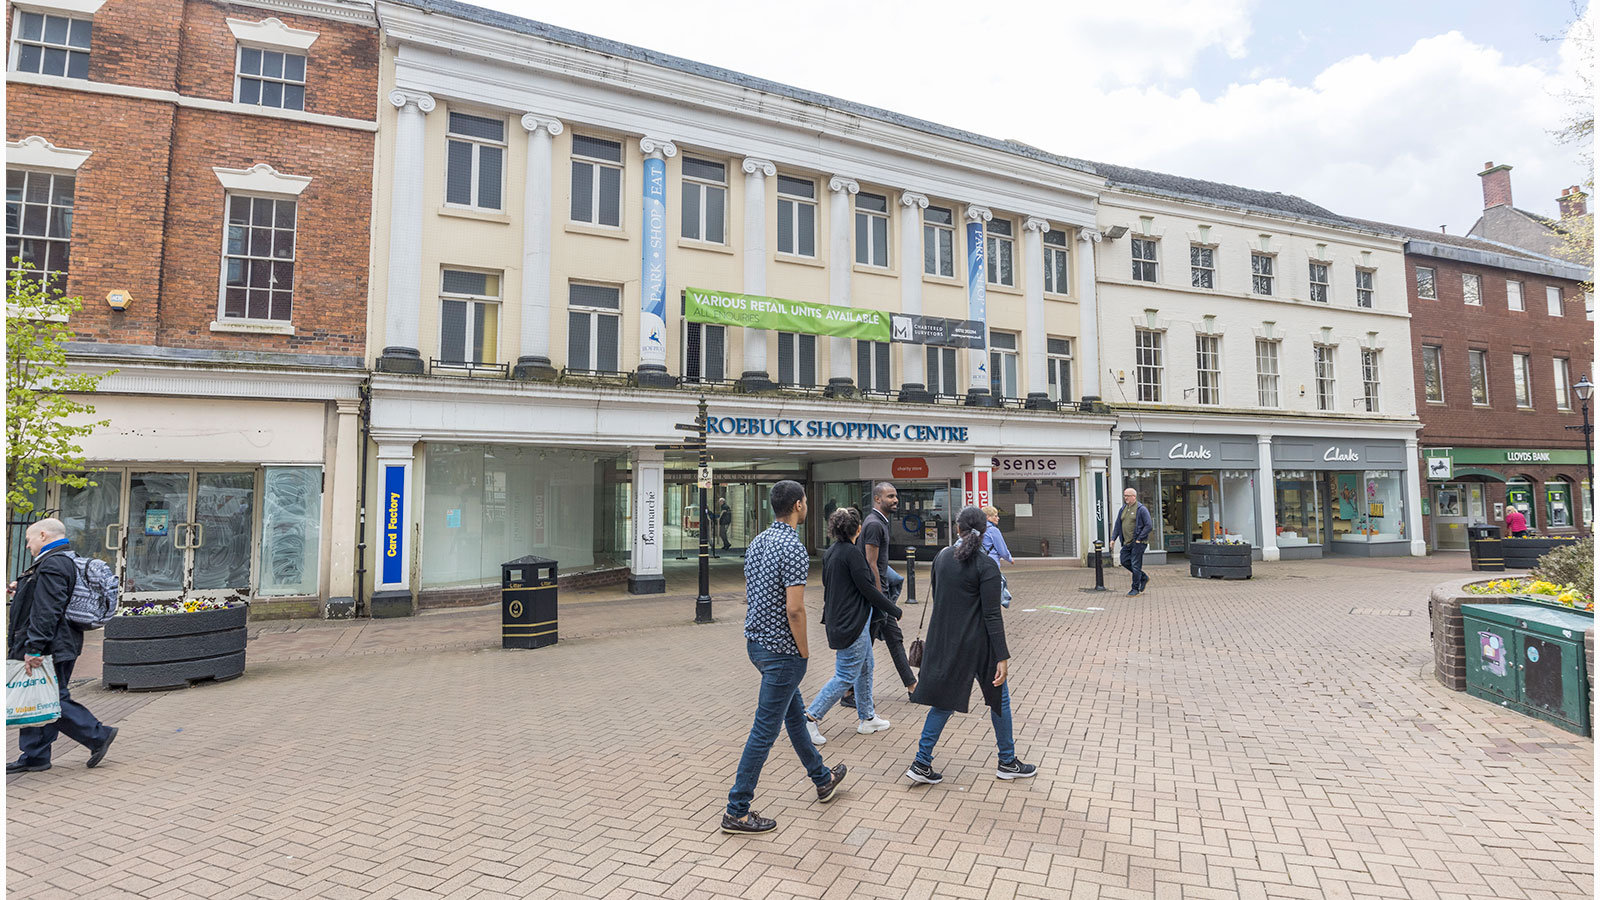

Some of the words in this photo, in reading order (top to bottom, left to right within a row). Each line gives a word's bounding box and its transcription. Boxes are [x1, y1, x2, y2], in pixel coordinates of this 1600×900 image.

[651, 167, 663, 195] EAT
[651, 208, 662, 248] SHOP
[651, 263, 662, 302] PARK
[693, 293, 747, 309] VARIOUS
[751, 301, 788, 314] RETAIL
[790, 306, 822, 318] UNITS
[825, 311, 880, 325] AVAILABLE
[693, 307, 710, 317] ALL
[713, 310, 760, 323] ENQUIRIES
[914, 324, 943, 332] CHARTERED
[707, 416, 803, 437] ROEBUCK
[806, 420, 901, 440] SHOPPING
[904, 424, 969, 443] CENTRE
[1168, 442, 1212, 460] Clarks
[1323, 446, 1359, 462] Clarks
[1507, 452, 1532, 461] LLOYDS
[1532, 452, 1551, 461] BANK
[1003, 459, 1057, 470] sense
[388, 492, 400, 530] Factory
[642, 491, 655, 545] Bonmarché
[387, 533, 397, 557] Card
